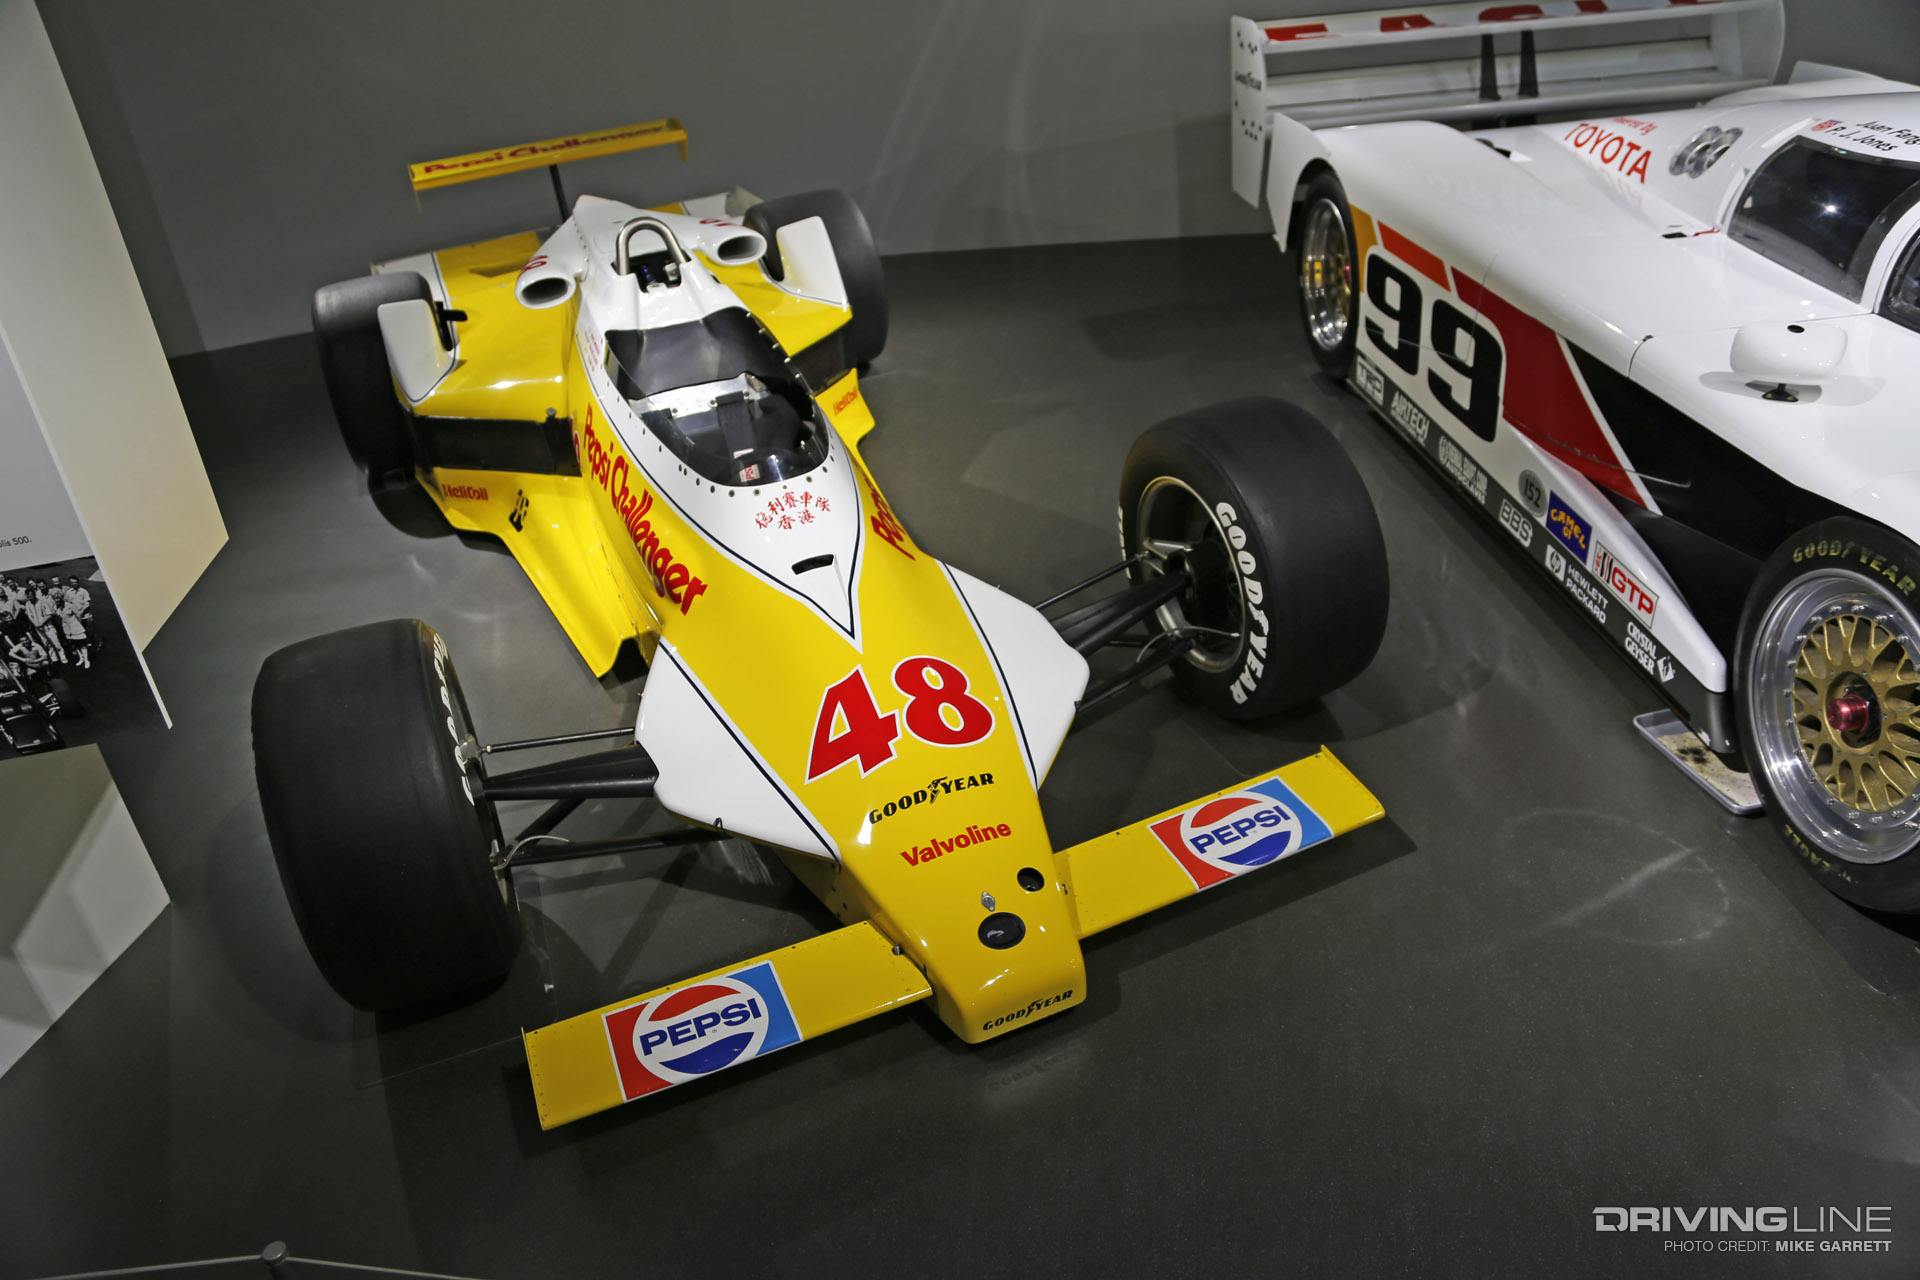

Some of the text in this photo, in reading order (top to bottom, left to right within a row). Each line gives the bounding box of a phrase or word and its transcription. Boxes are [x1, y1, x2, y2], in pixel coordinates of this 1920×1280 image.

[1564, 123, 1652, 183] TOYOTA
[1852, 135, 1898, 151] Jones
[1888, 128, 1920, 145] Fang
[1365, 254, 1502, 442] 99
[442, 484, 488, 501] HeliCoil
[583, 403, 707, 615] Pepsi Challenger
[12, 535, 32, 545] 500.
[777, 508, 816, 530] 香港
[1501, 501, 1533, 545] BBS
[1550, 508, 1586, 549] CAMEL
[1215, 502, 1269, 704] GOODYEAR
[1566, 577, 1607, 624] PACKARD
[1567, 564, 1608, 609] HEWLETT
[1612, 567, 1654, 615] GTP
[1624, 636, 1655, 676] GEYSER
[1627, 621, 1657, 660] CRYSTAL
[805, 656, 995, 784] 48
[868, 773, 994, 824] GOODYEAR
[900, 823, 1012, 867] Valvoline
[1189, 805, 1291, 854] PEPSI
[639, 997, 762, 1057] PEPSI
[982, 989, 1073, 1031] GOODYEAR
